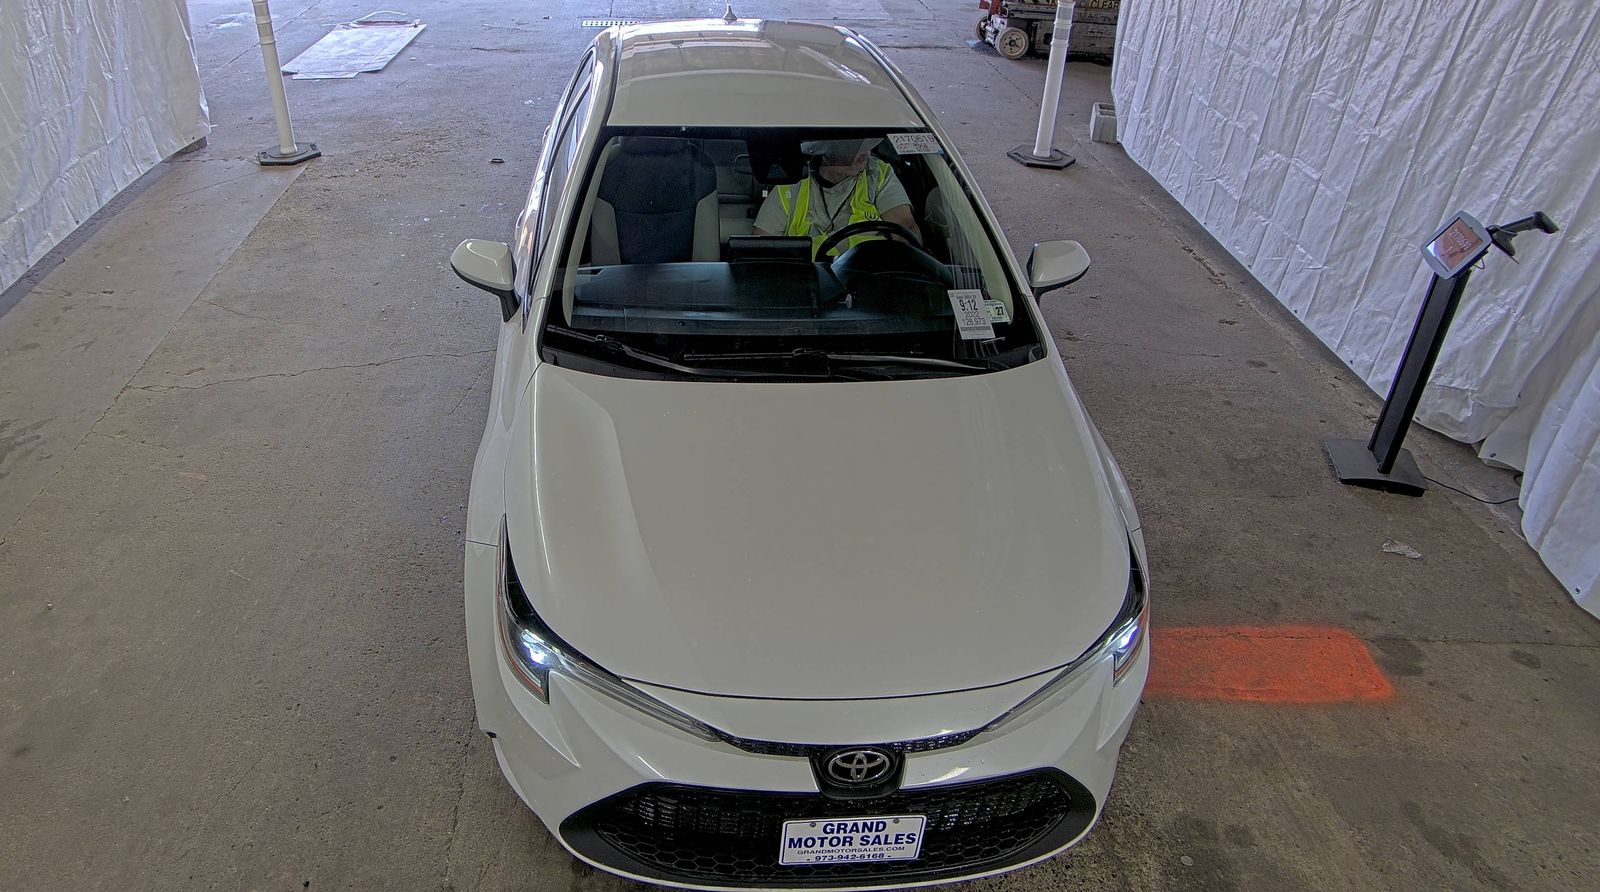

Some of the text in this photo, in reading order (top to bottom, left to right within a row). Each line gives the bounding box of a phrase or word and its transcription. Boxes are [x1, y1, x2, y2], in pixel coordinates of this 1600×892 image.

[959, 299, 978, 311] 9:12
[995, 306, 1004, 316] 27
[822, 821, 887, 834] GRAND
[788, 833, 917, 849] MOTOR SALES
[797, 846, 905, 855] GRANDMOTORSALES.COM
[814, 853, 885, 862] 973-942-6168
